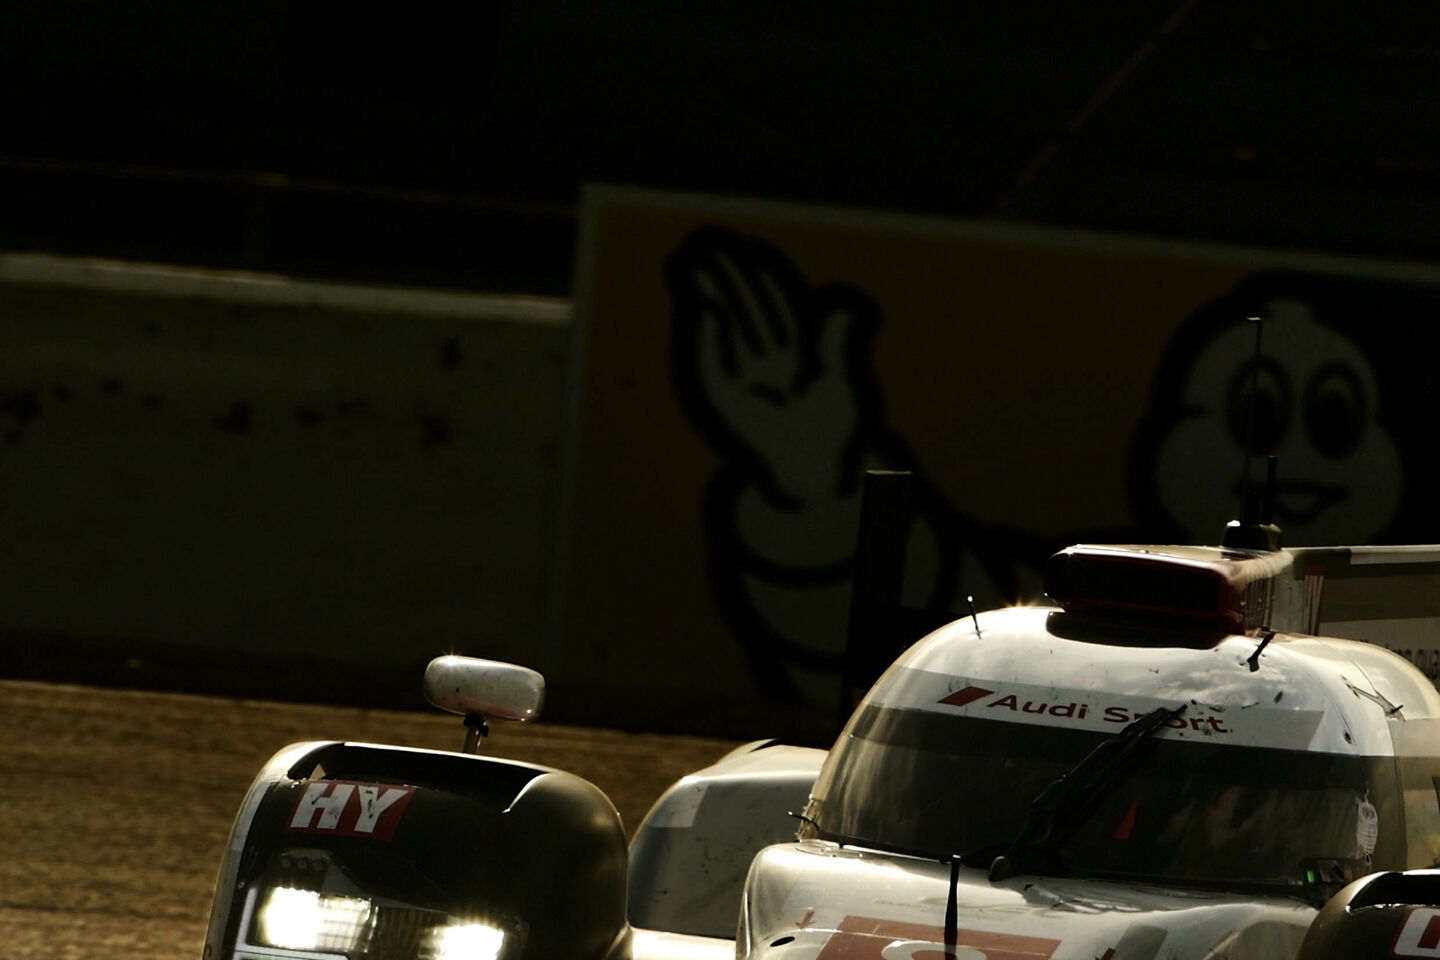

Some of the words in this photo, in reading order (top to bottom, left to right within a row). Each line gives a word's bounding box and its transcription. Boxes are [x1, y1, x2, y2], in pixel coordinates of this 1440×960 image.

[988, 695, 1087, 719] Audi
[1104, 706, 1228, 733] Sort
[290, 782, 408, 833] HY
